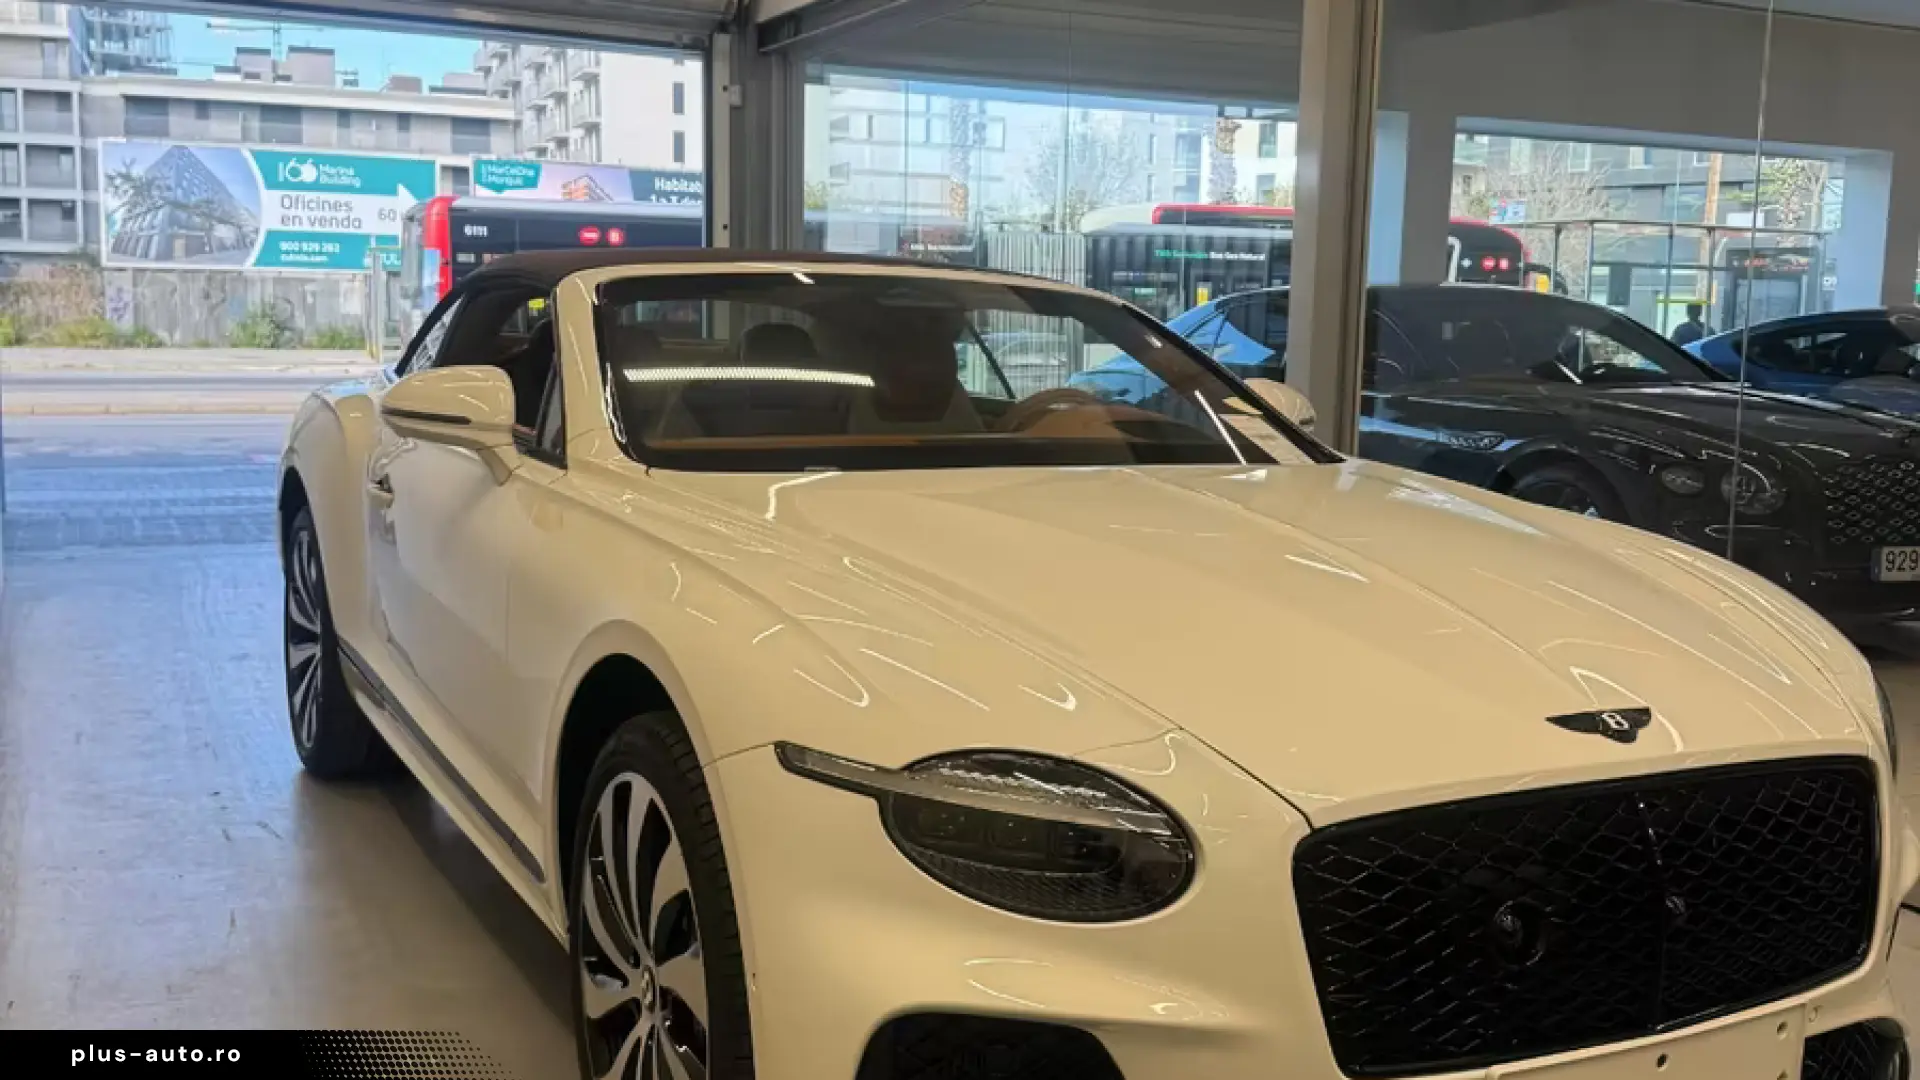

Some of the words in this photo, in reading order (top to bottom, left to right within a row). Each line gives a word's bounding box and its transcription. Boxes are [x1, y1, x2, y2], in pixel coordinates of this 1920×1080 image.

[319, 164, 355, 176] Marina
[319, 174, 361, 188] Building
[280, 194, 354, 212] Oficines
[280, 214, 304, 227] en
[307, 214, 362, 229] venda
[1886, 550, 1919, 573] 929
